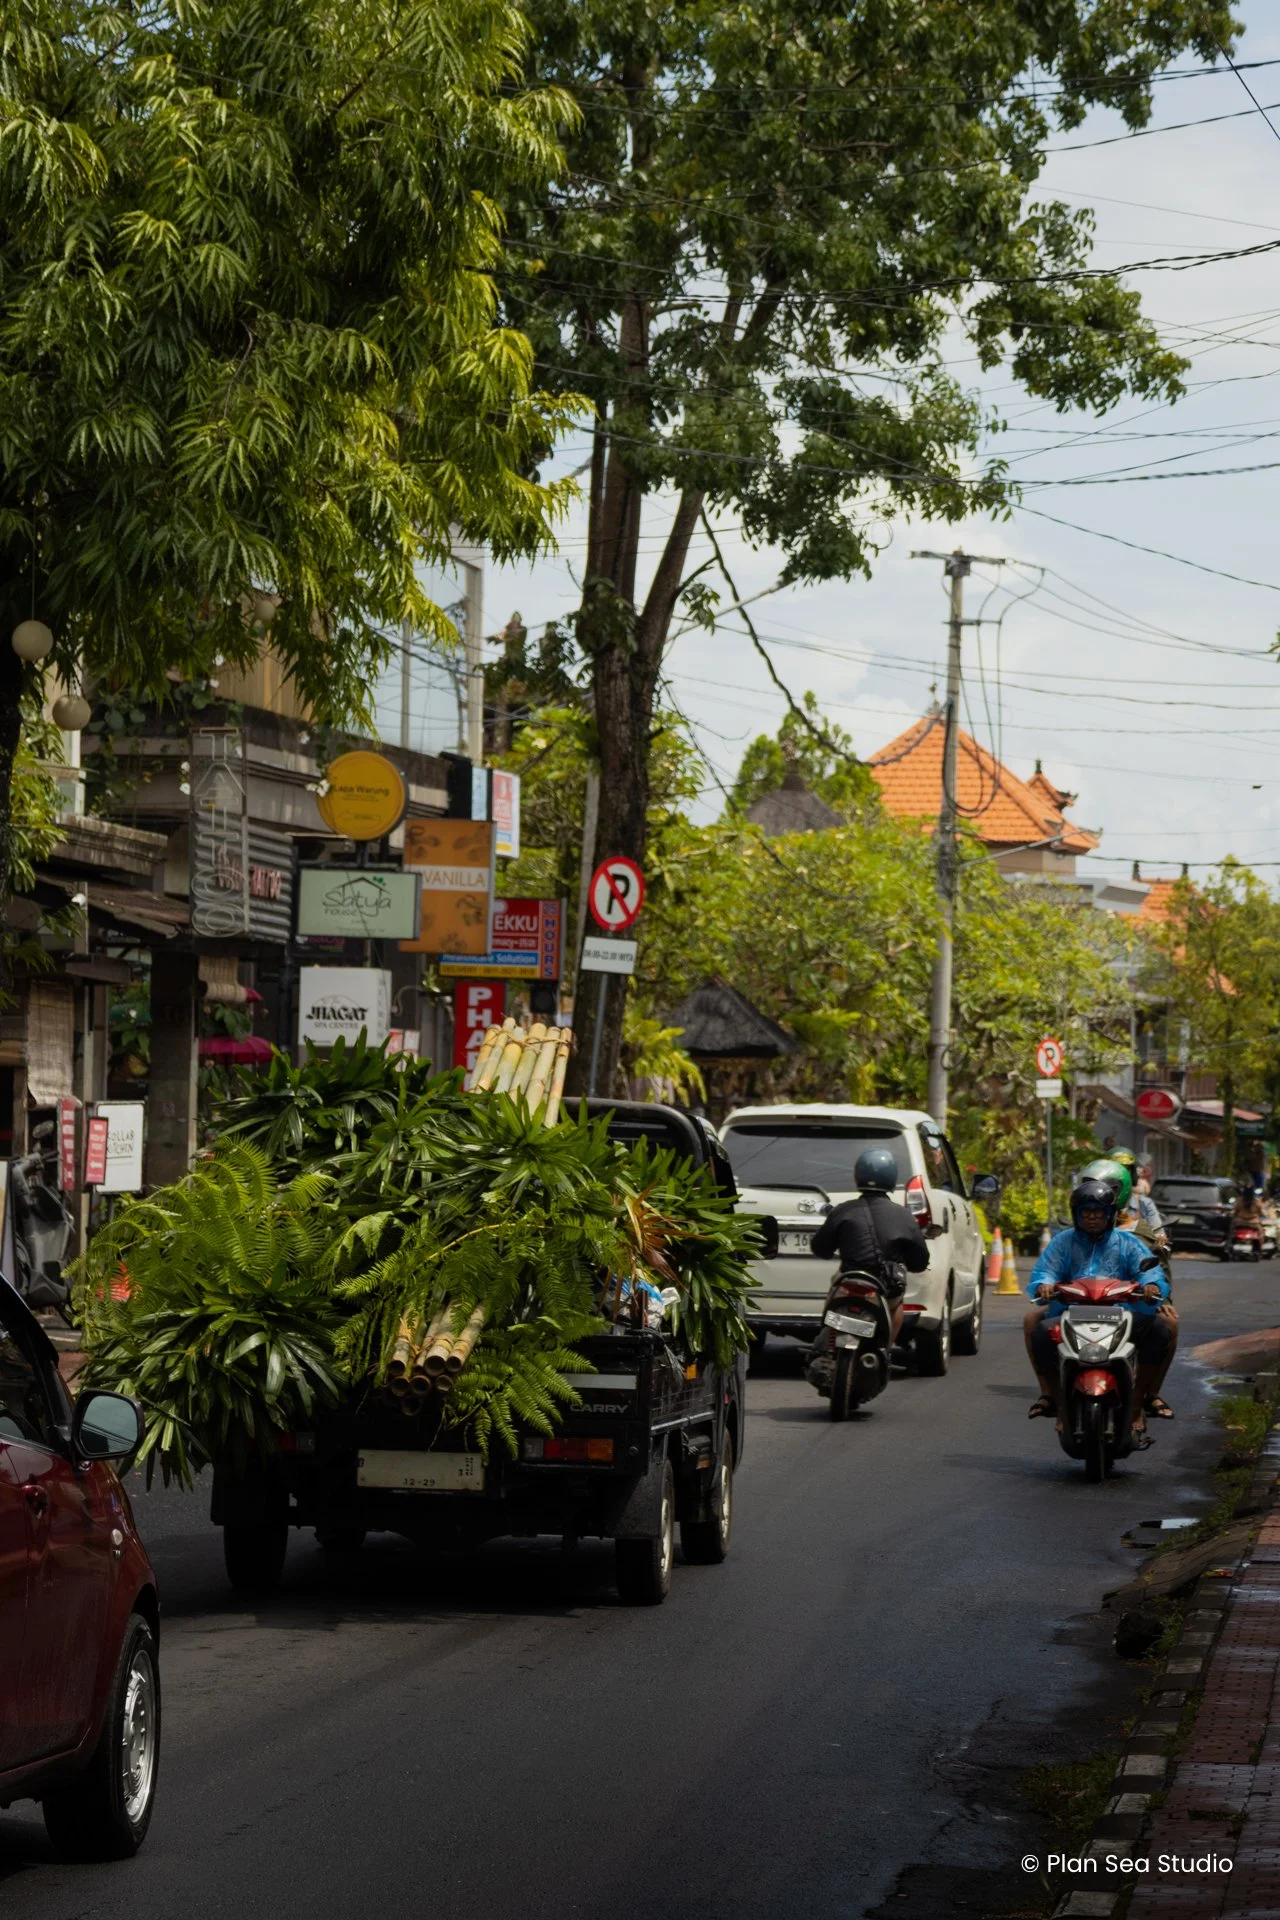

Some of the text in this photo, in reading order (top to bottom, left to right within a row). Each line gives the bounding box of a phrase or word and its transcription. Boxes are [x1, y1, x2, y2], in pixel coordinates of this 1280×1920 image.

[422, 869, 485, 886] VANILLA
[322, 889, 392, 917] Satya
[495, 953, 537, 966] Solution
[464, 985, 493, 1092] PHA
[569, 1403, 629, 1414] CARRY
